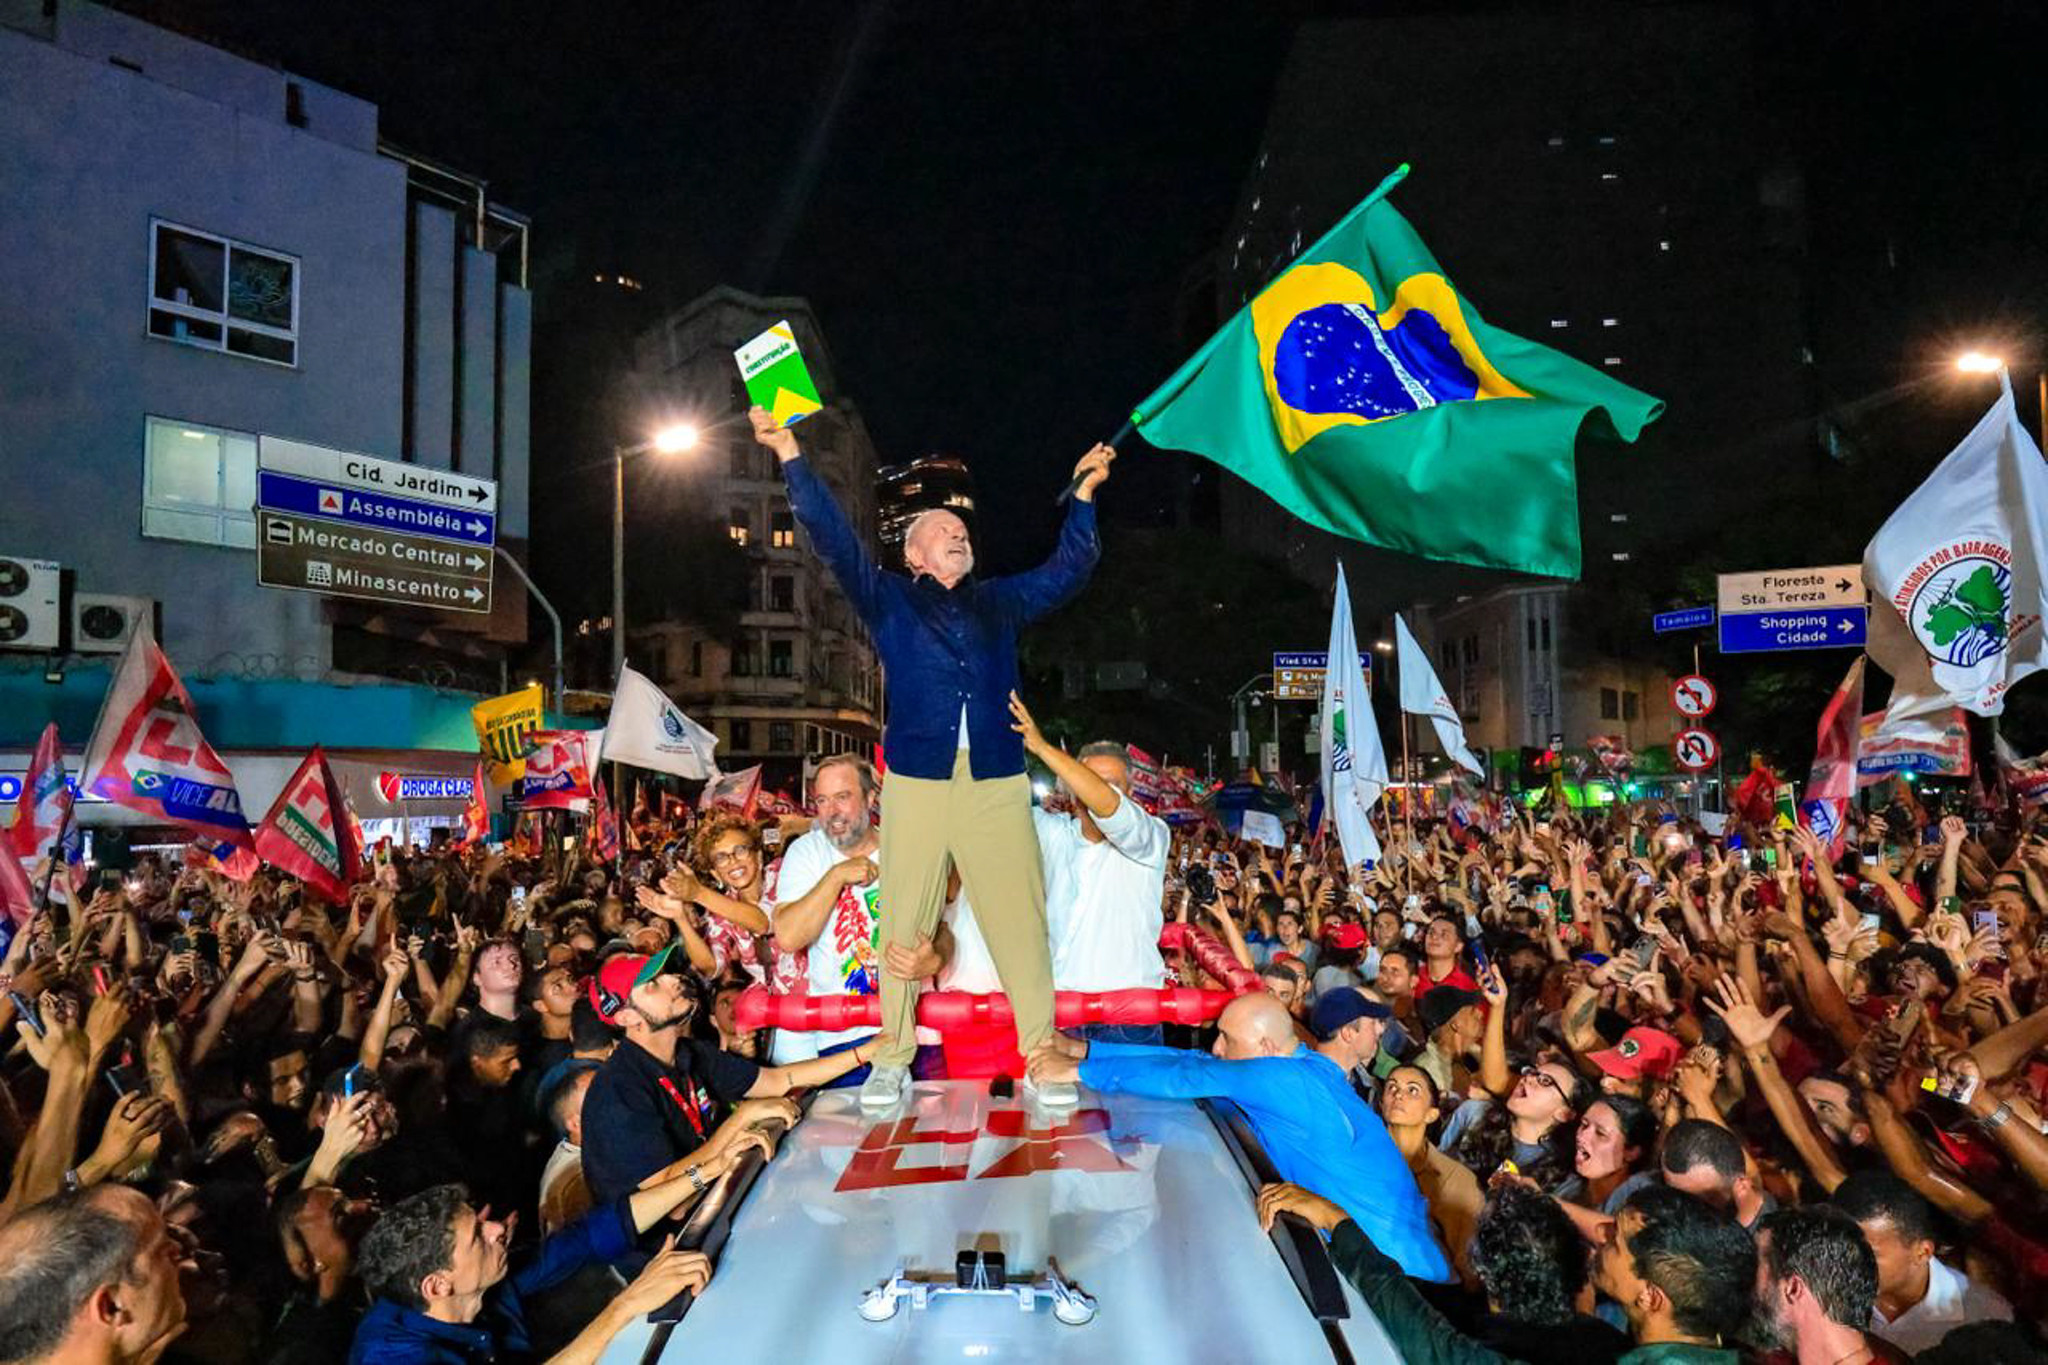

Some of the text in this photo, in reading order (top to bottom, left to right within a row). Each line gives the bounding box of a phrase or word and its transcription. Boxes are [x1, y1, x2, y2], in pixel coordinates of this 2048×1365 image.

[347, 462, 463, 498] Cid. Jardim
[349, 498, 462, 532] Assembléia
[298, 527, 461, 567] Mercado Central
[336, 567, 460, 599] Minascentro
[1763, 575, 1825, 589] Floresta
[1894, 560, 1934, 607] ATINGIDOS
[1930, 547, 1952, 568] POR
[1776, 589, 1826, 603] Tereza
[1760, 615, 1827, 630] Shopping
[1777, 631, 1827, 645] Cidade
[173, 781, 211, 808] VICE
[402, 780, 442, 796] DROGA
